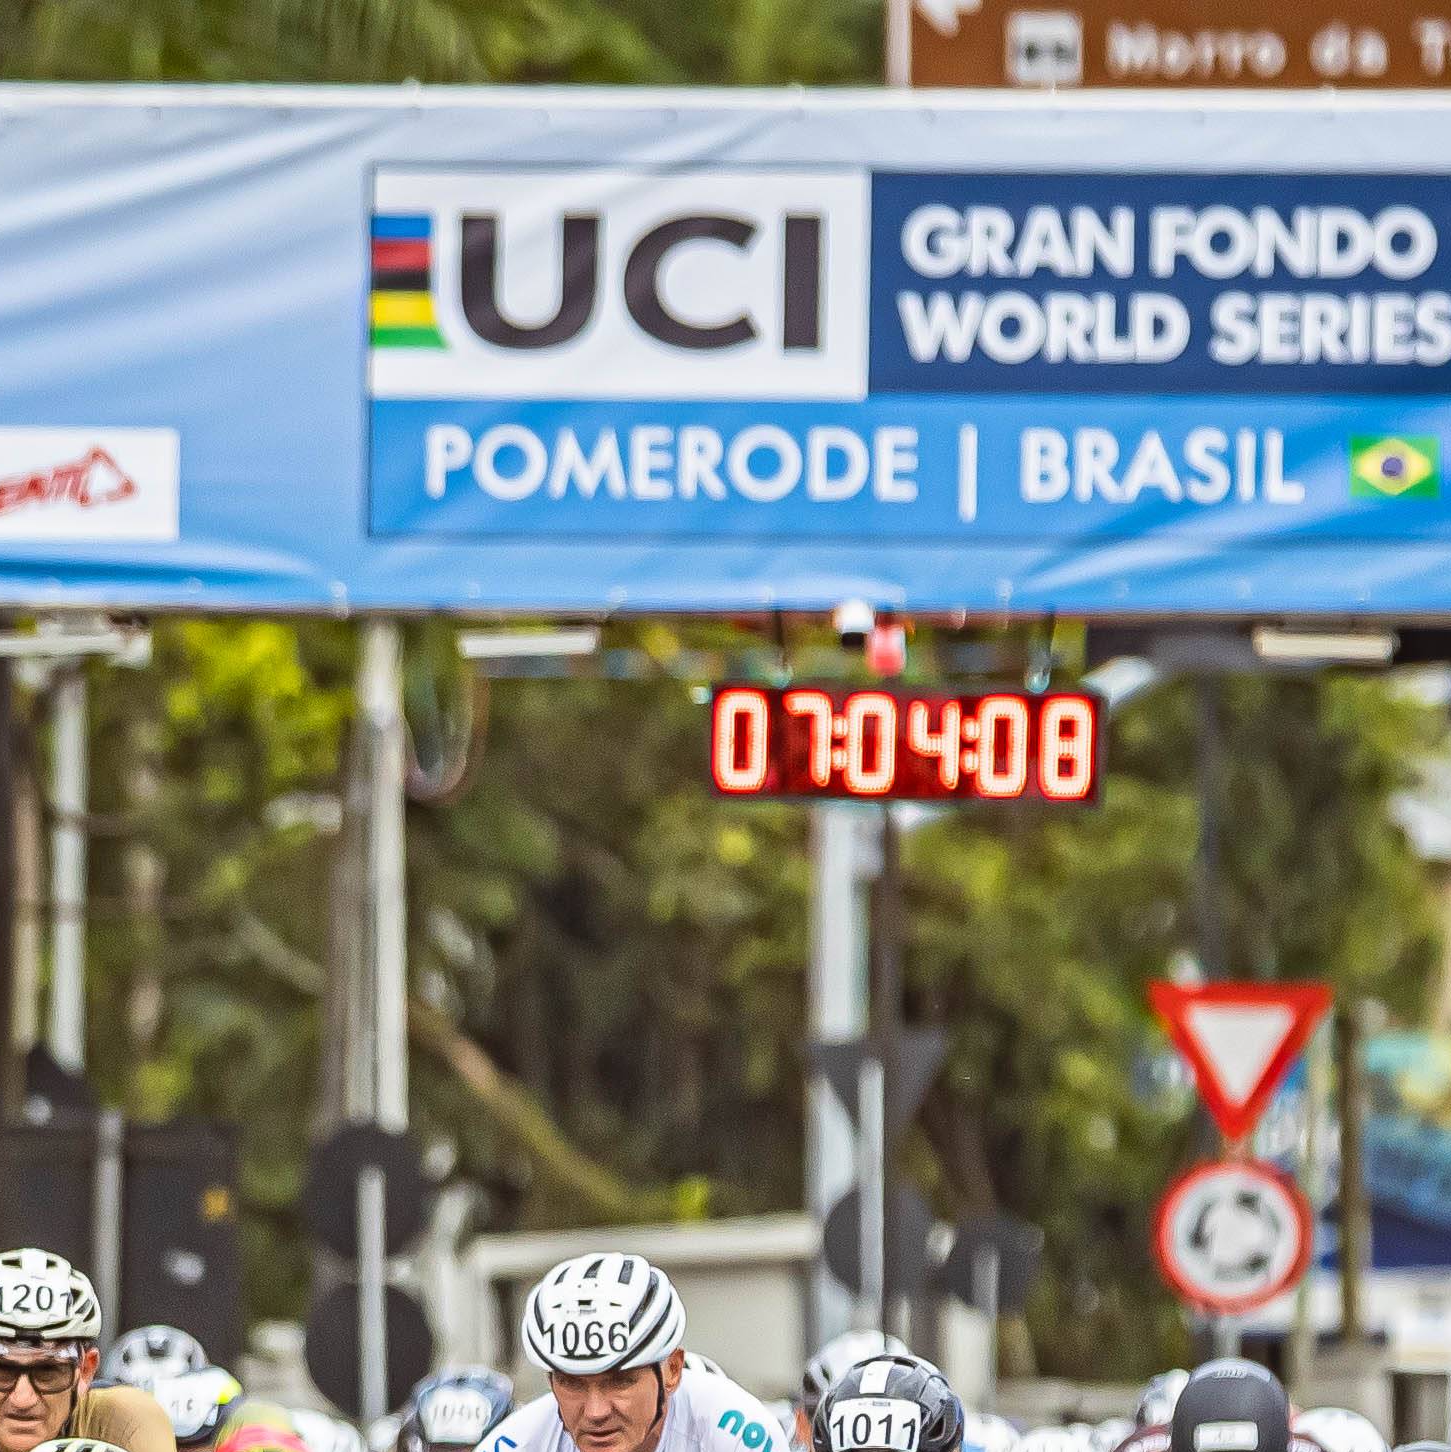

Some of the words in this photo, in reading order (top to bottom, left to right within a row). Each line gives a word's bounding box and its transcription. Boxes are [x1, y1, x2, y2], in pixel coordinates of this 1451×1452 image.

[1311, 24, 1388, 77] da
[900, 204, 1136, 280] GRAN
[1156, 204, 1439, 281] FONDO
[458, 211, 825, 351] UCI
[899, 291, 1191, 366] WORLD
[425, 423, 921, 507] POMERODE
[1019, 428, 1306, 507] BRASIL
[545, 1322, 629, 1355] 1066
[832, 1413, 918, 1450] 1011
